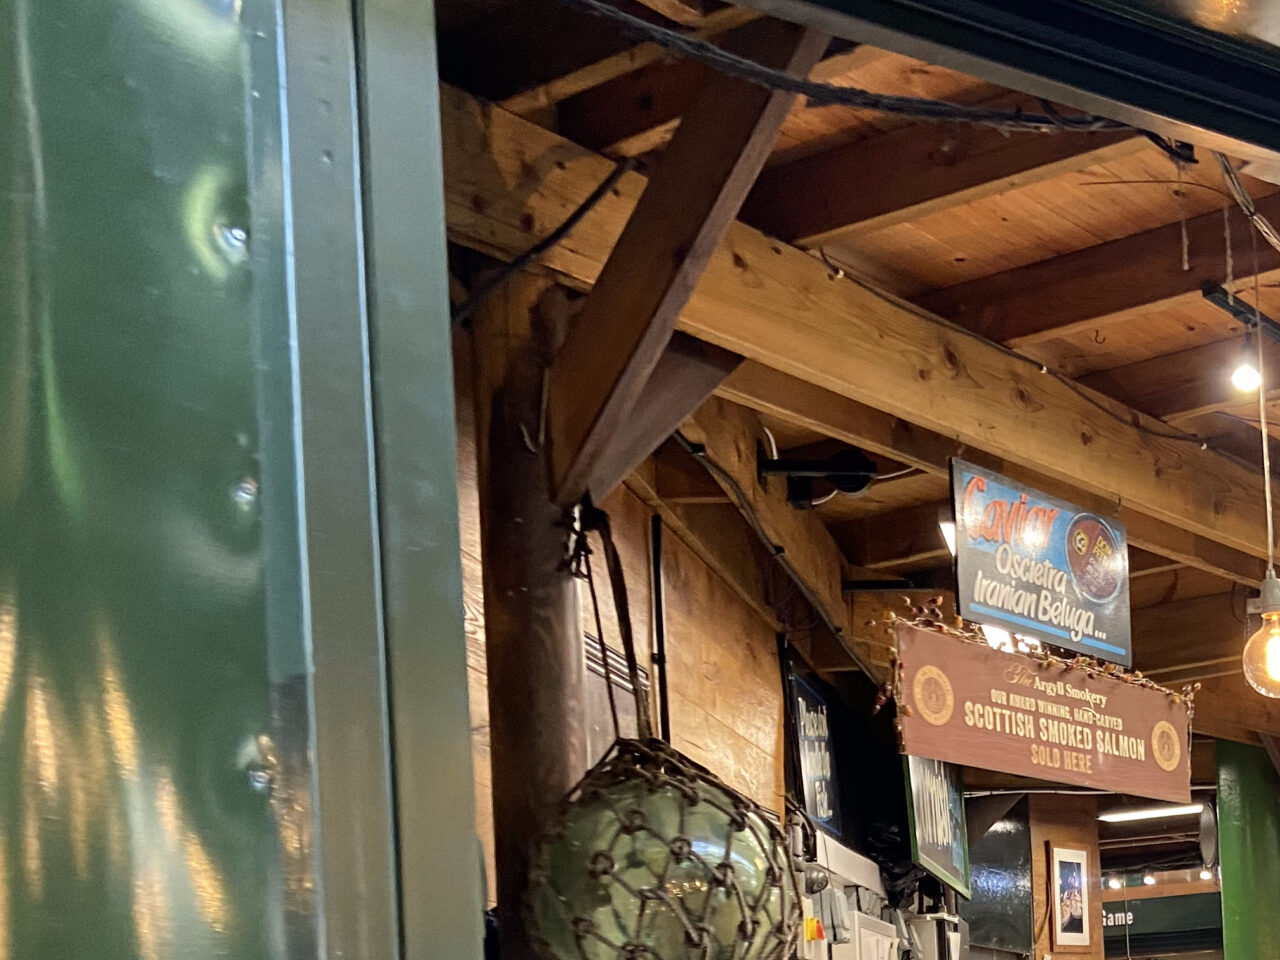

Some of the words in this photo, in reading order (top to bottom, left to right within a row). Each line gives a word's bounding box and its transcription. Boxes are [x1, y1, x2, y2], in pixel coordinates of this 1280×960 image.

[964, 476, 1060, 547] Caviar
[995, 543, 1068, 594] Oscietra
[973, 570, 1036, 619] Iranian
[990, 689, 1007, 705] OUR
[1009, 693, 1036, 712] AWARD
[1074, 707, 1123, 731] HAND-CARVED
[1003, 663, 1037, 687] The
[1033, 677, 1065, 697] Argyll
[1065, 685, 1107, 708] Smokery
[964, 701, 1035, 739] SCOTTISH
[1039, 717, 1093, 750] SMOKED
[1096, 729, 1146, 762] SALMON
[1031, 744, 1060, 769] SOLD
[1064, 752, 1093, 774] HERE
